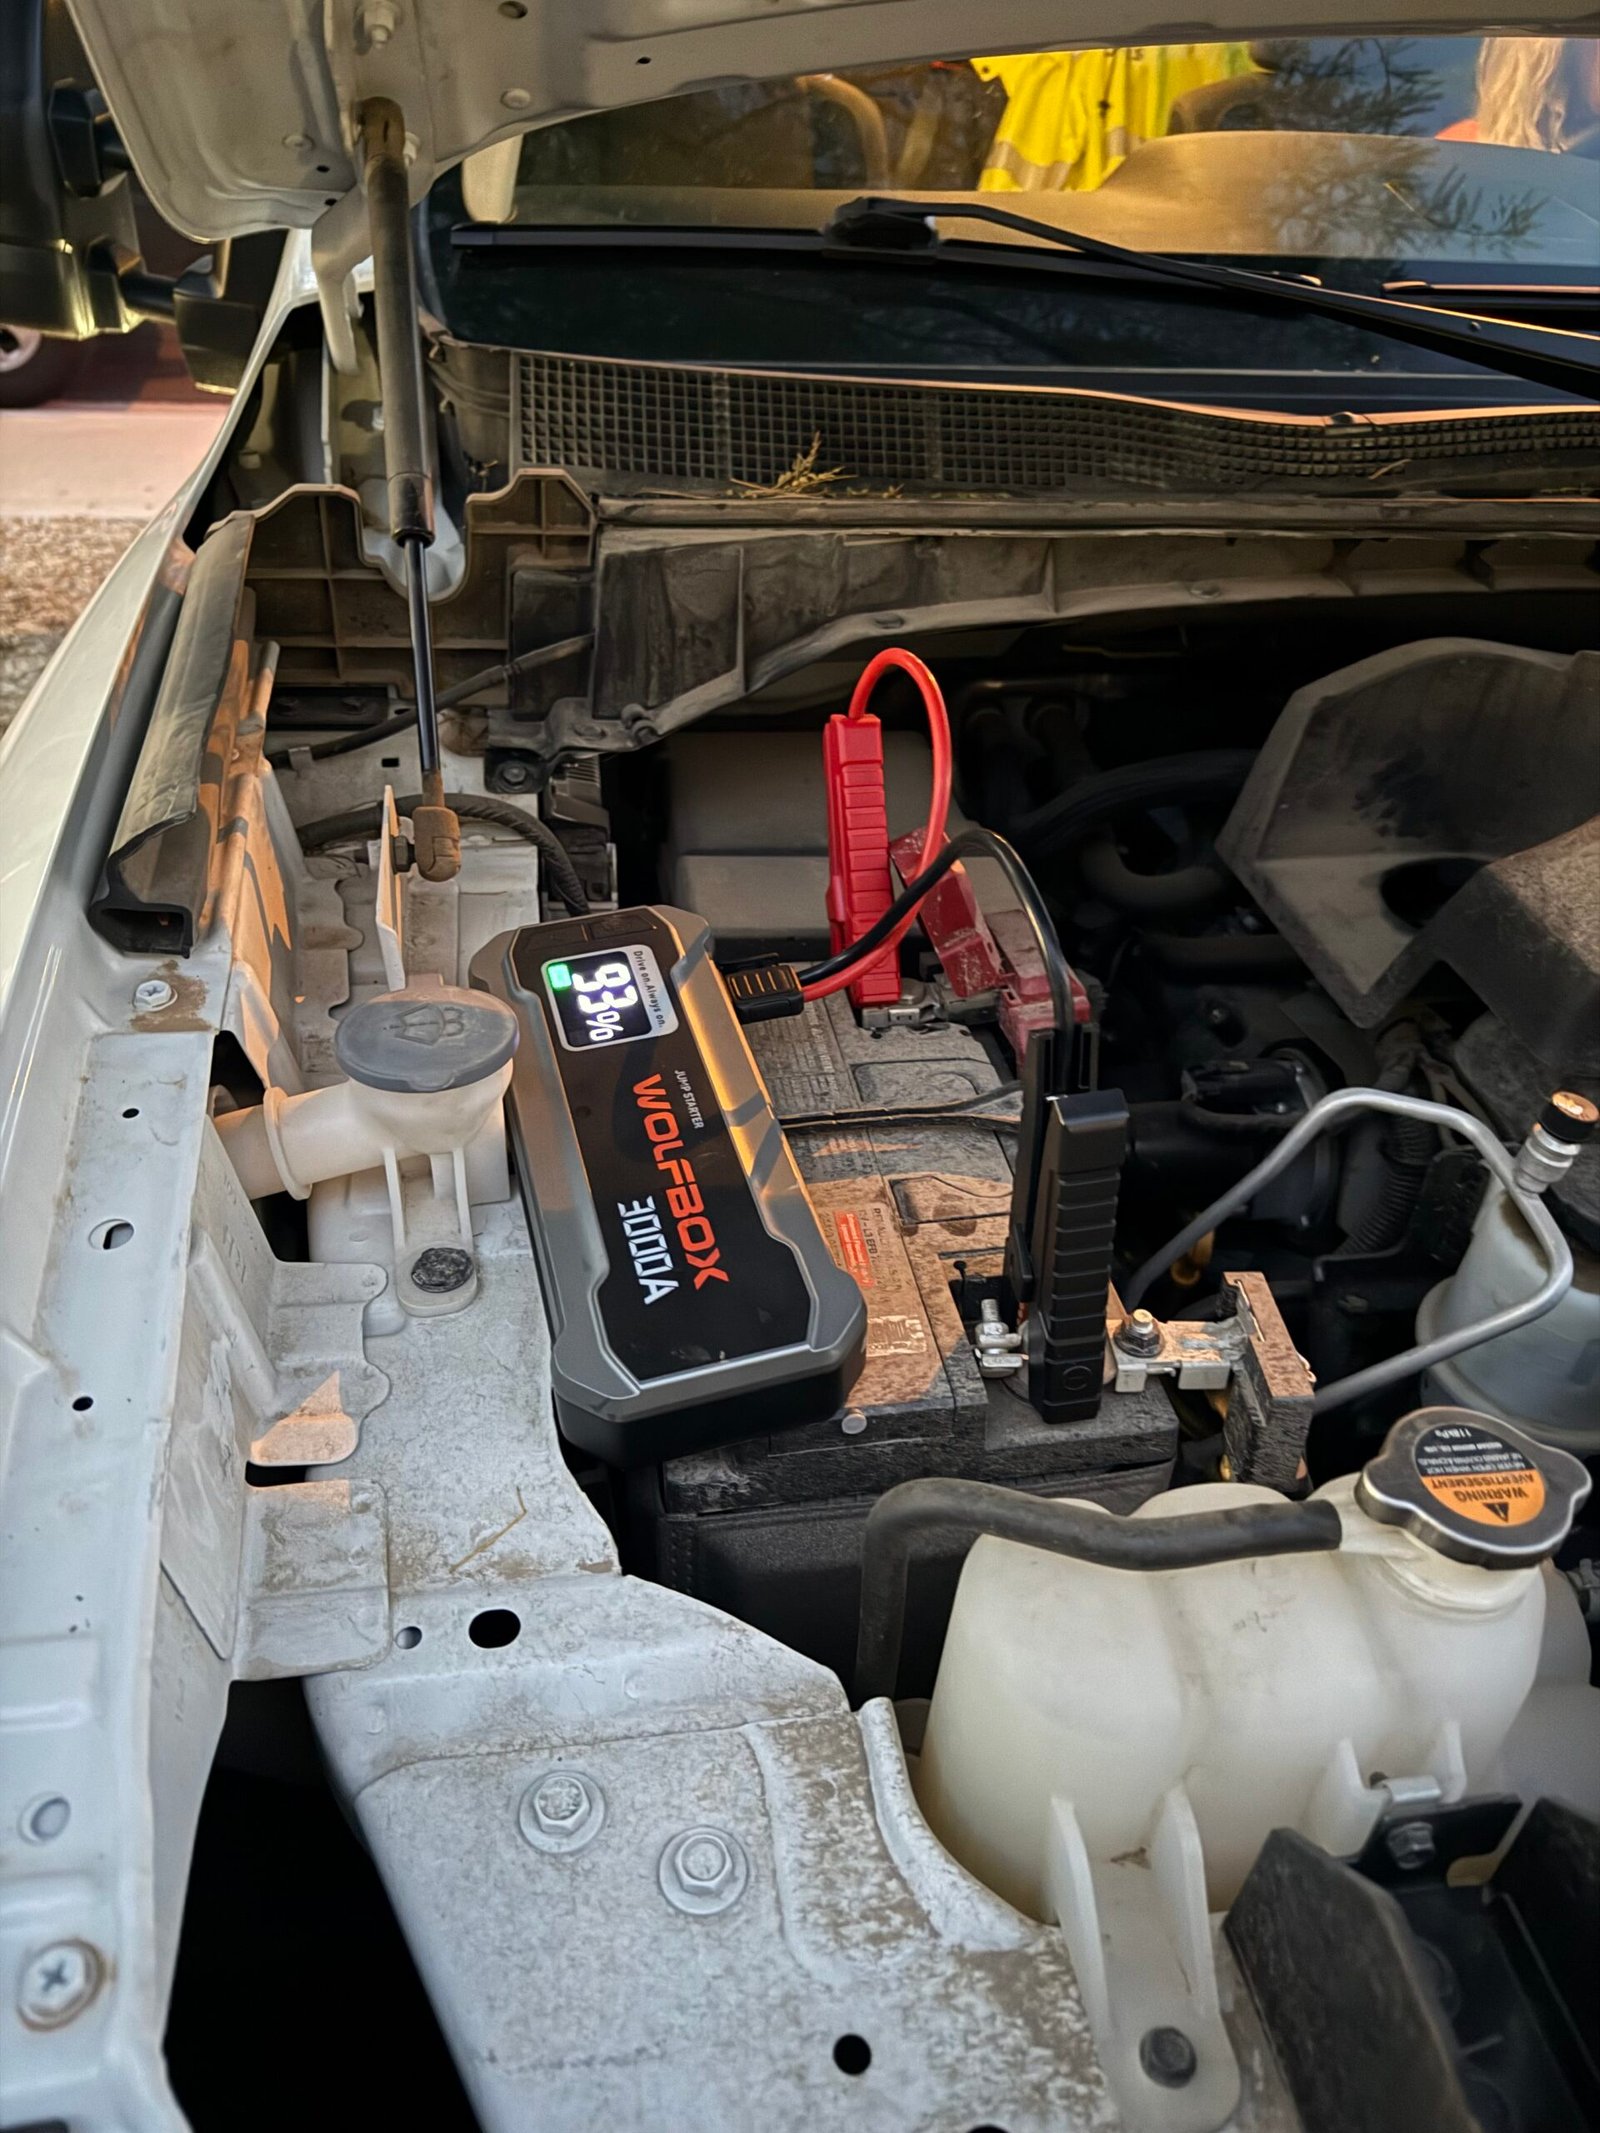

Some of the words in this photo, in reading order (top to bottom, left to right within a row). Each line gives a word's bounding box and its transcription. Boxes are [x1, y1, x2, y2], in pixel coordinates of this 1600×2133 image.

[633, 950, 647, 971] Drive
[674, 1070, 691, 1092] JUMP
[684, 1091, 704, 1129] STARTER
[632, 1073, 730, 1291] WOLFBOX
[617, 1195, 679, 1305] 3000A
[1431, 1474, 1534, 1489] AVERTISSEMENT
[1453, 1487, 1528, 1502] WARNING
